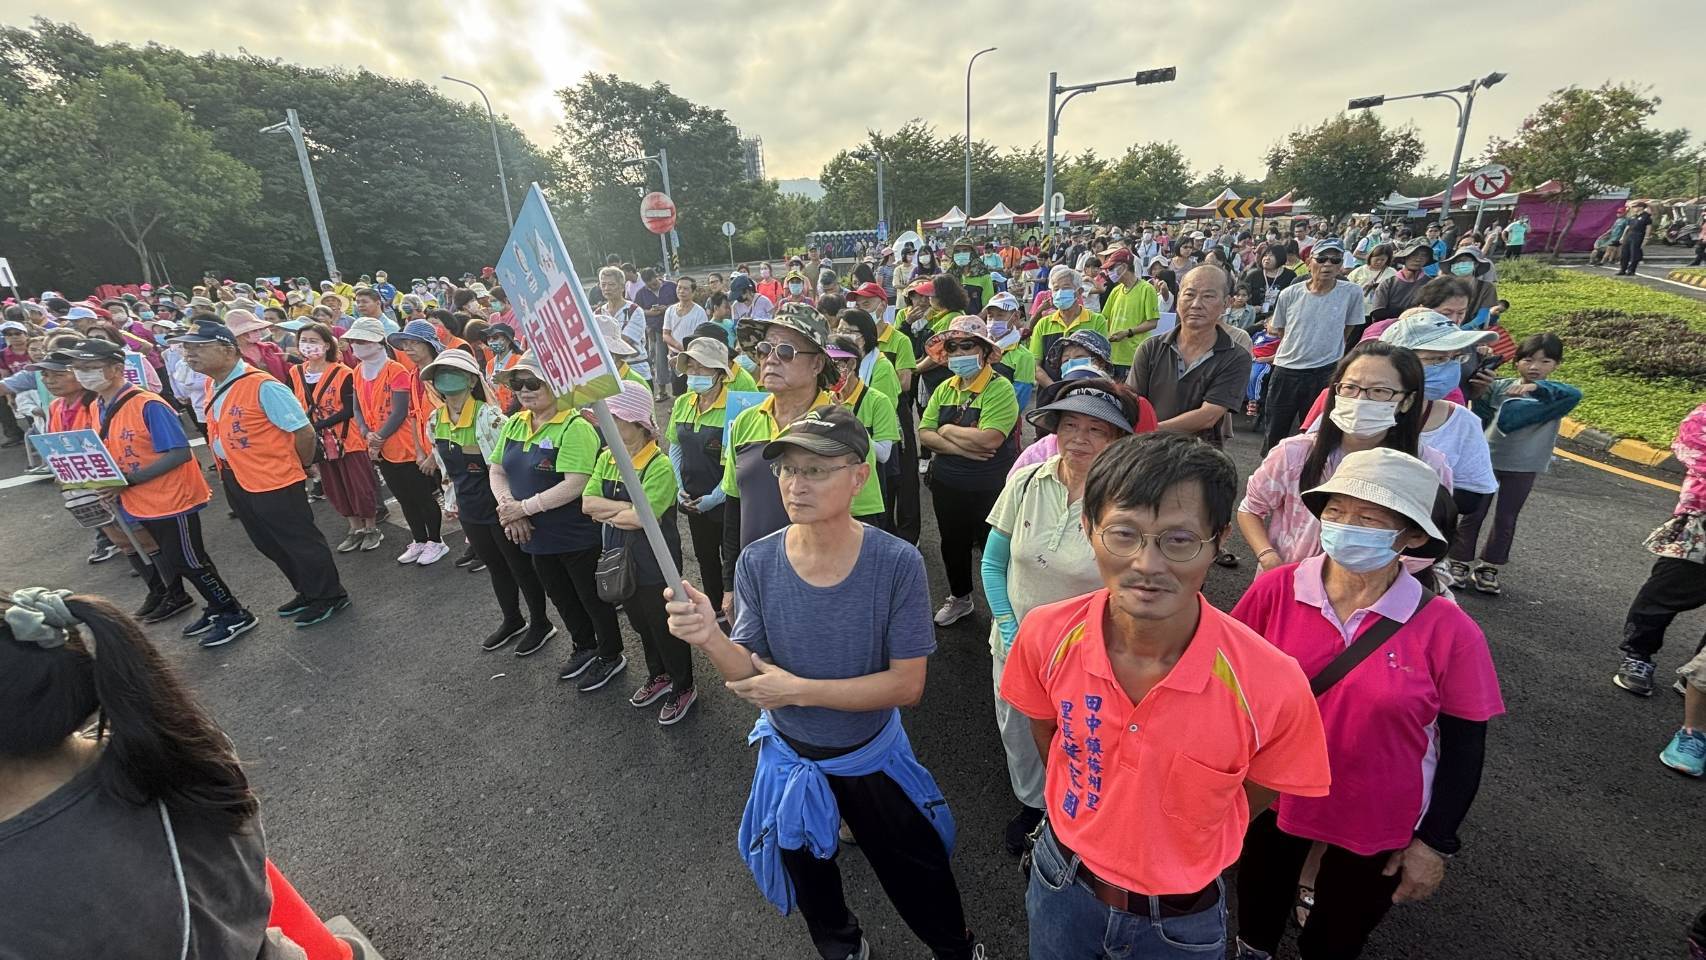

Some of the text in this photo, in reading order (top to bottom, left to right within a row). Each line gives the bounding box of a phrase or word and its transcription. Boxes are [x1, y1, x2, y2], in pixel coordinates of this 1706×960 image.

[525, 281, 603, 391] 梅州里
[228, 405, 251, 449] 新民里
[49, 453, 117, 481] 新民里
